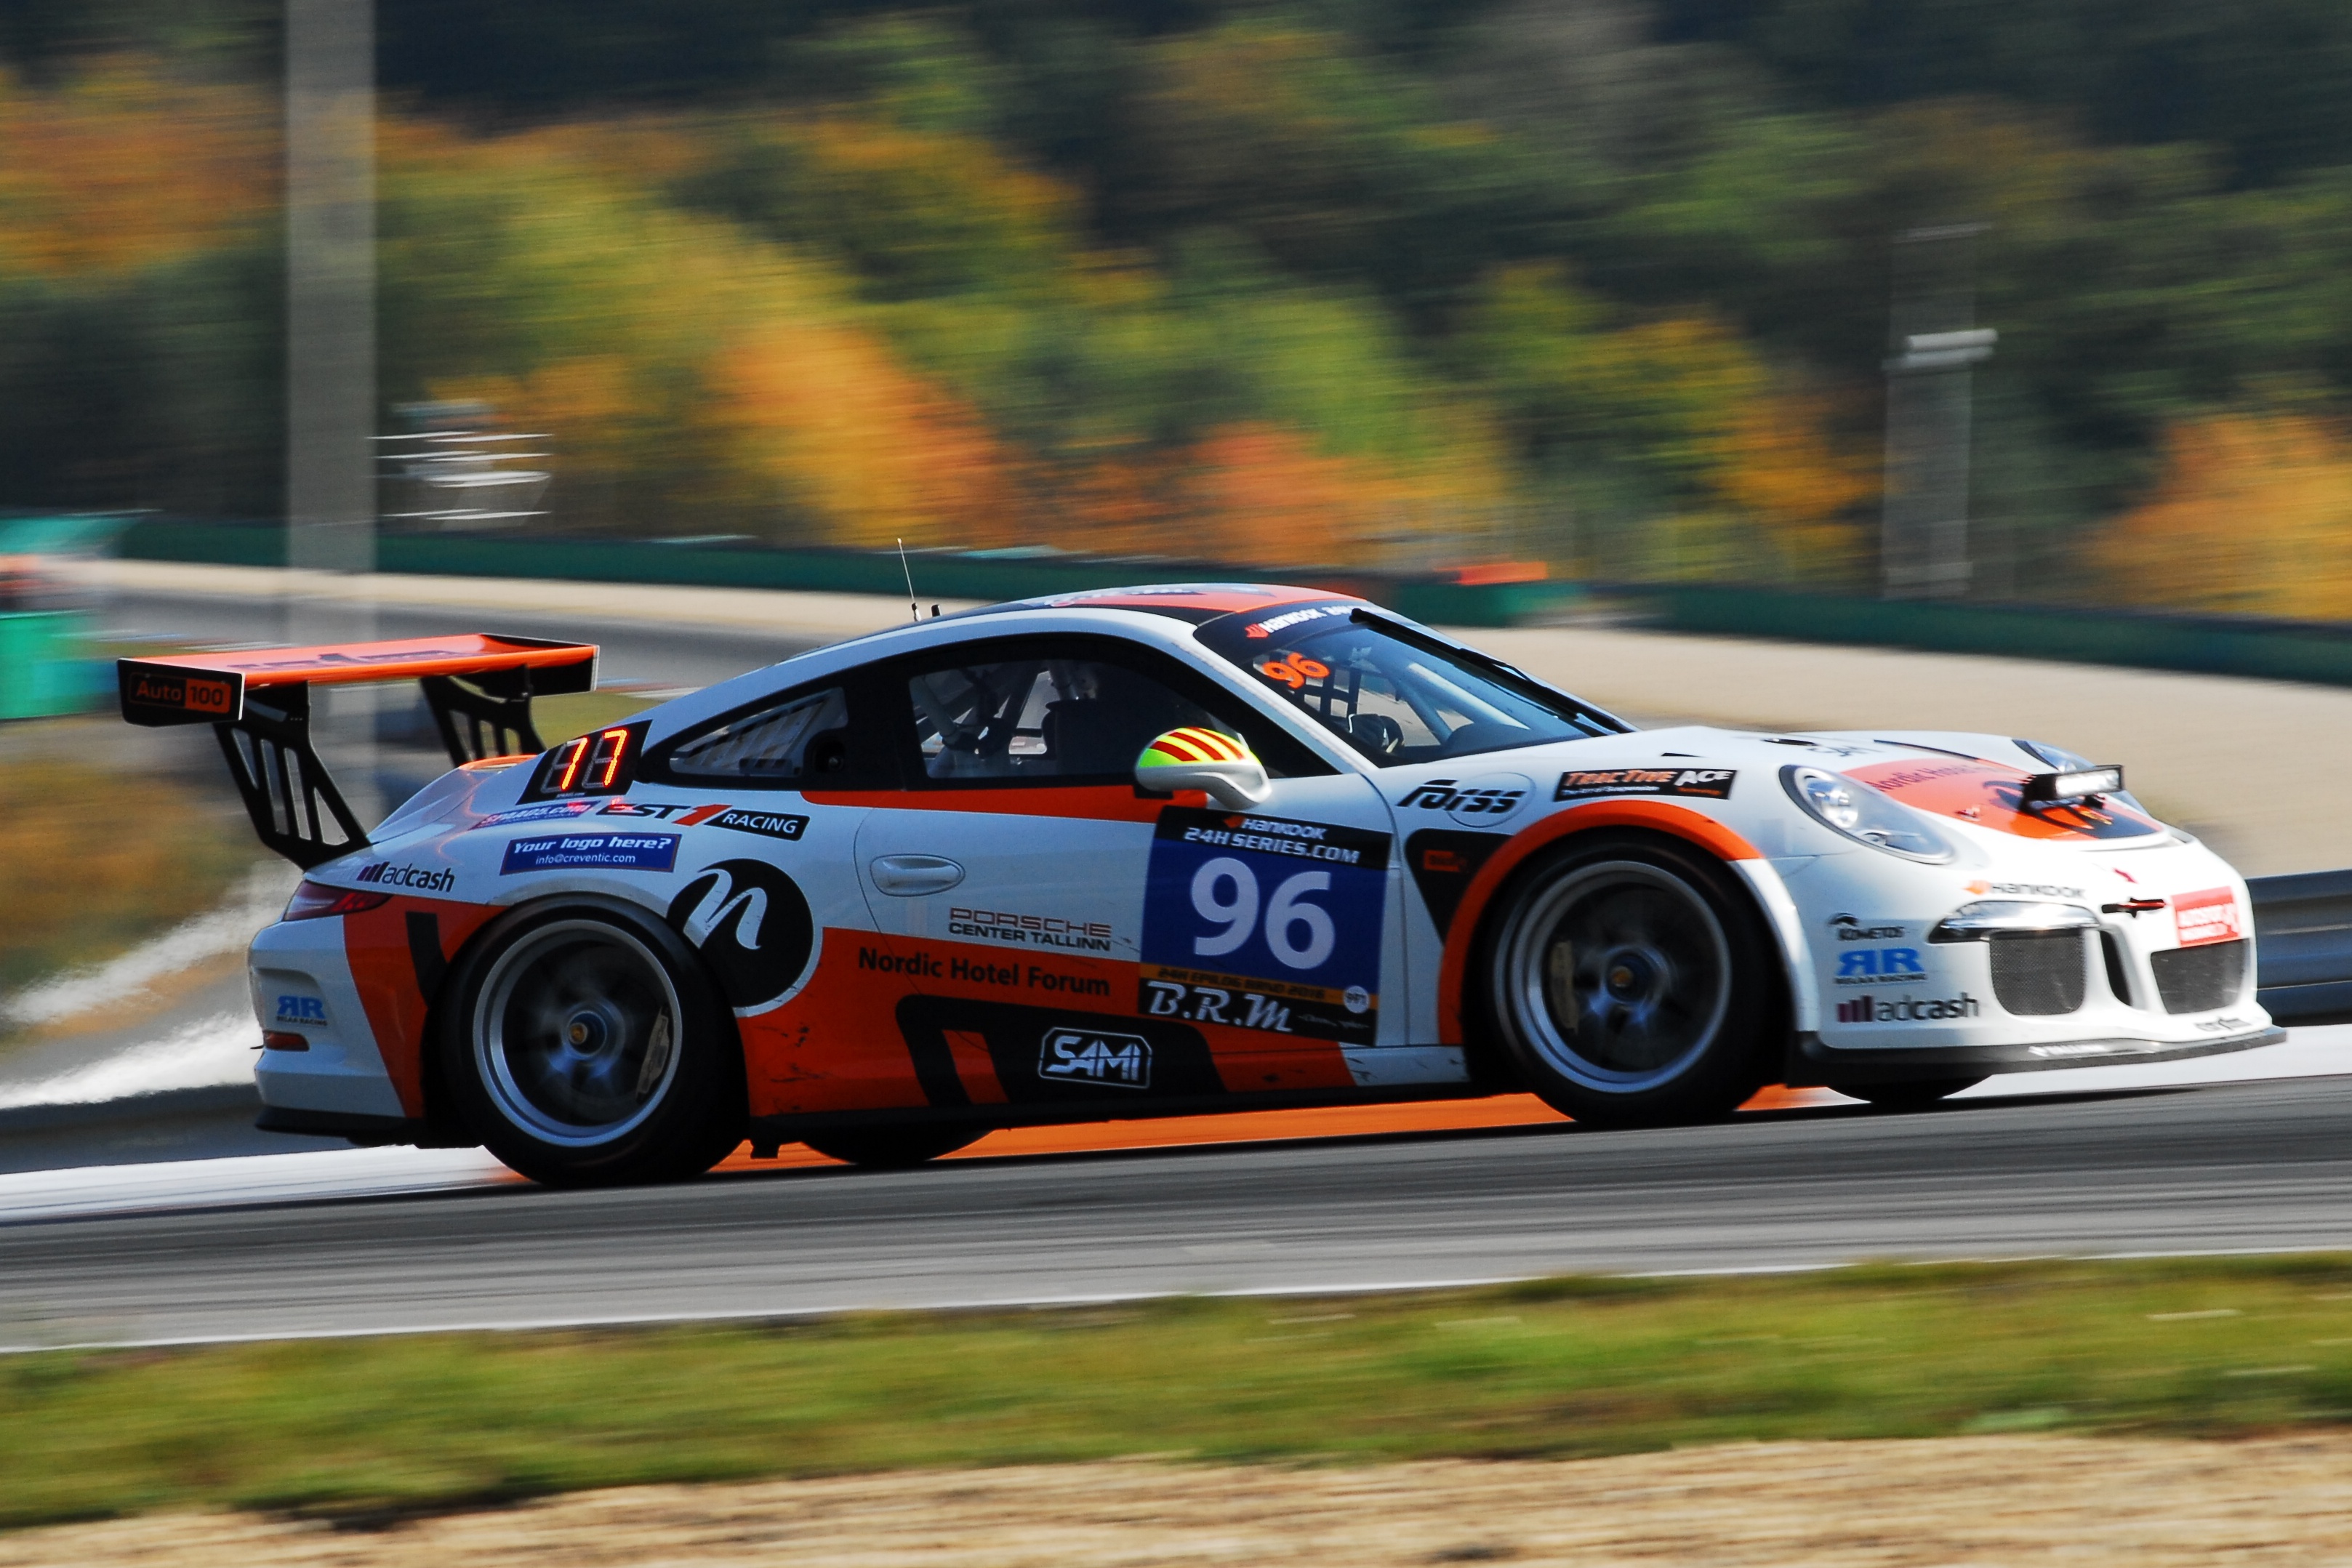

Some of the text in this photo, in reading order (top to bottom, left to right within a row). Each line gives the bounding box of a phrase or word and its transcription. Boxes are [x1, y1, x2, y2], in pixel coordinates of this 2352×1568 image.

[1261, 652, 1331, 689] 96
[136, 679, 223, 706] Auto 100
[1674, 771, 1733, 787] ACE
[722, 813, 799, 834] RACING
[514, 836, 672, 854] Your logo here?
[535, 853, 636, 865] info@creventic.com
[382, 863, 455, 893] adcash
[950, 906, 1112, 938] PORSCHE
[1190, 857, 1335, 970] 96
[949, 922, 1111, 952] CENTER TALLINN
[859, 946, 1111, 997] Nordic Hotel Forum
[1876, 992, 1979, 1021] adcash
[1045, 1035, 1141, 1081] SAMI
